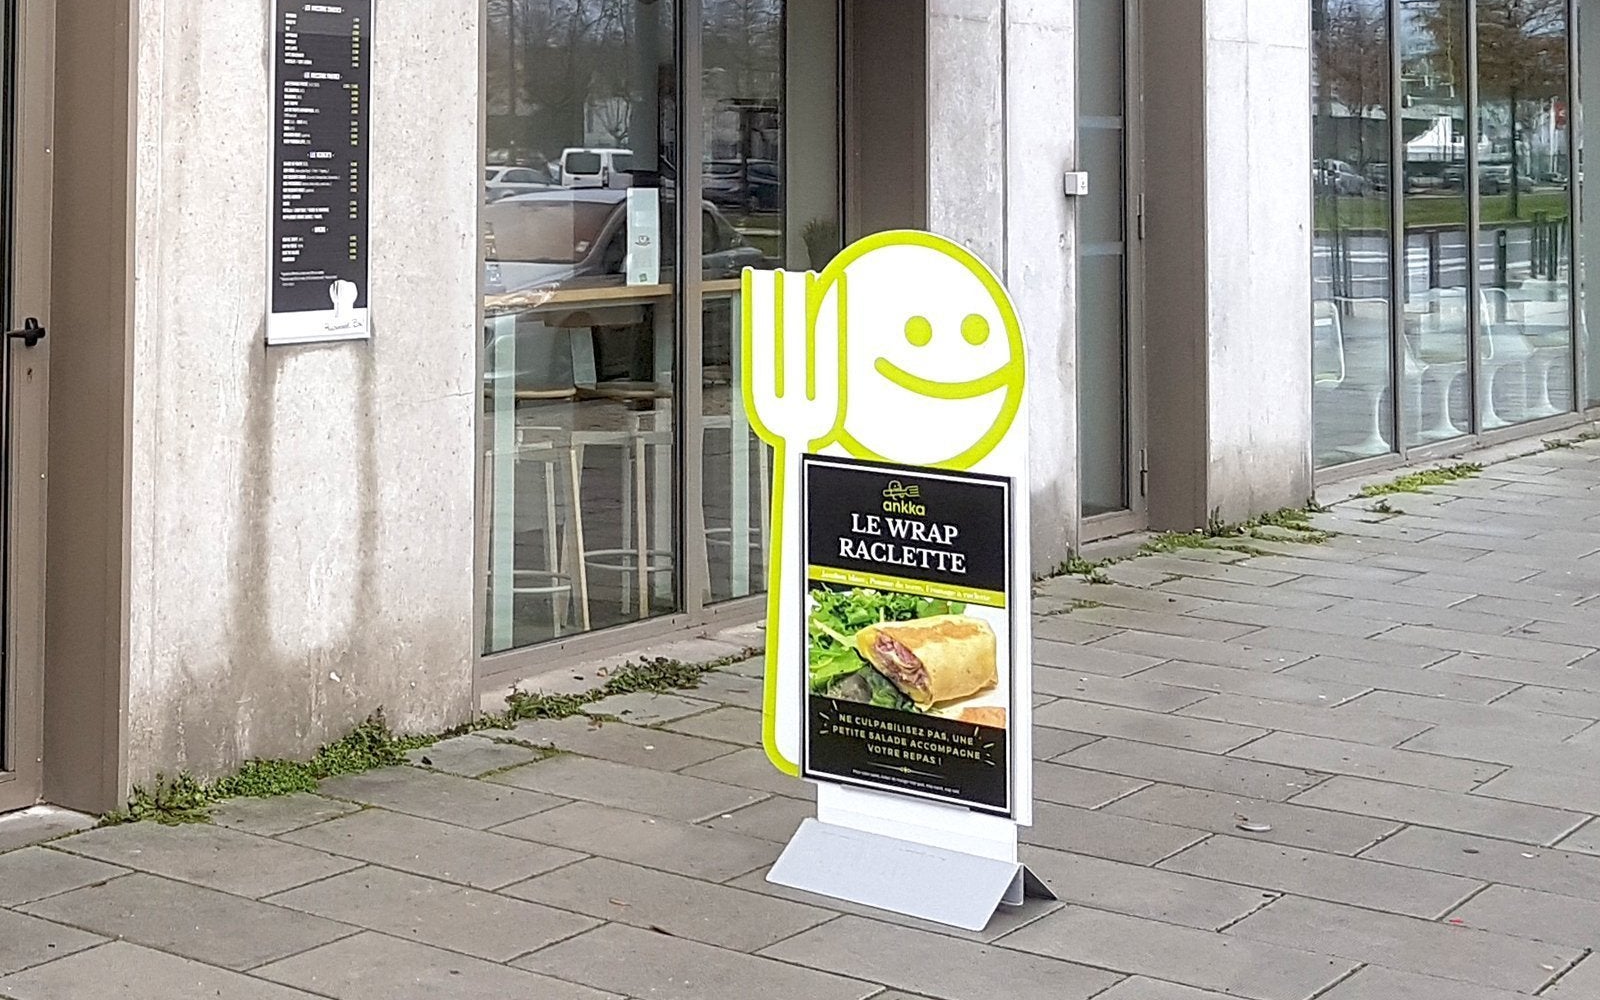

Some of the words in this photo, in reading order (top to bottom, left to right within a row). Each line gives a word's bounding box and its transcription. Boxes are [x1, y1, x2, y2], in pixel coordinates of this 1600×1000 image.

[882, 498, 926, 517] ankka
[851, 513, 882, 536] LE
[885, 517, 959, 545] WRAP
[838, 537, 967, 574] RACLETTE
[832, 725, 866, 739] PETITE
[868, 731, 907, 746] SALADE
[910, 740, 981, 760] ACCOMPAGNE
[839, 713, 853, 724] NE
[854, 715, 925, 737] CULPABILISEZ
[927, 729, 950, 742] PAS,
[952, 734, 974, 746] UNE
[867, 743, 900, 758] VOTRE
[903, 750, 936, 765] REPAS
